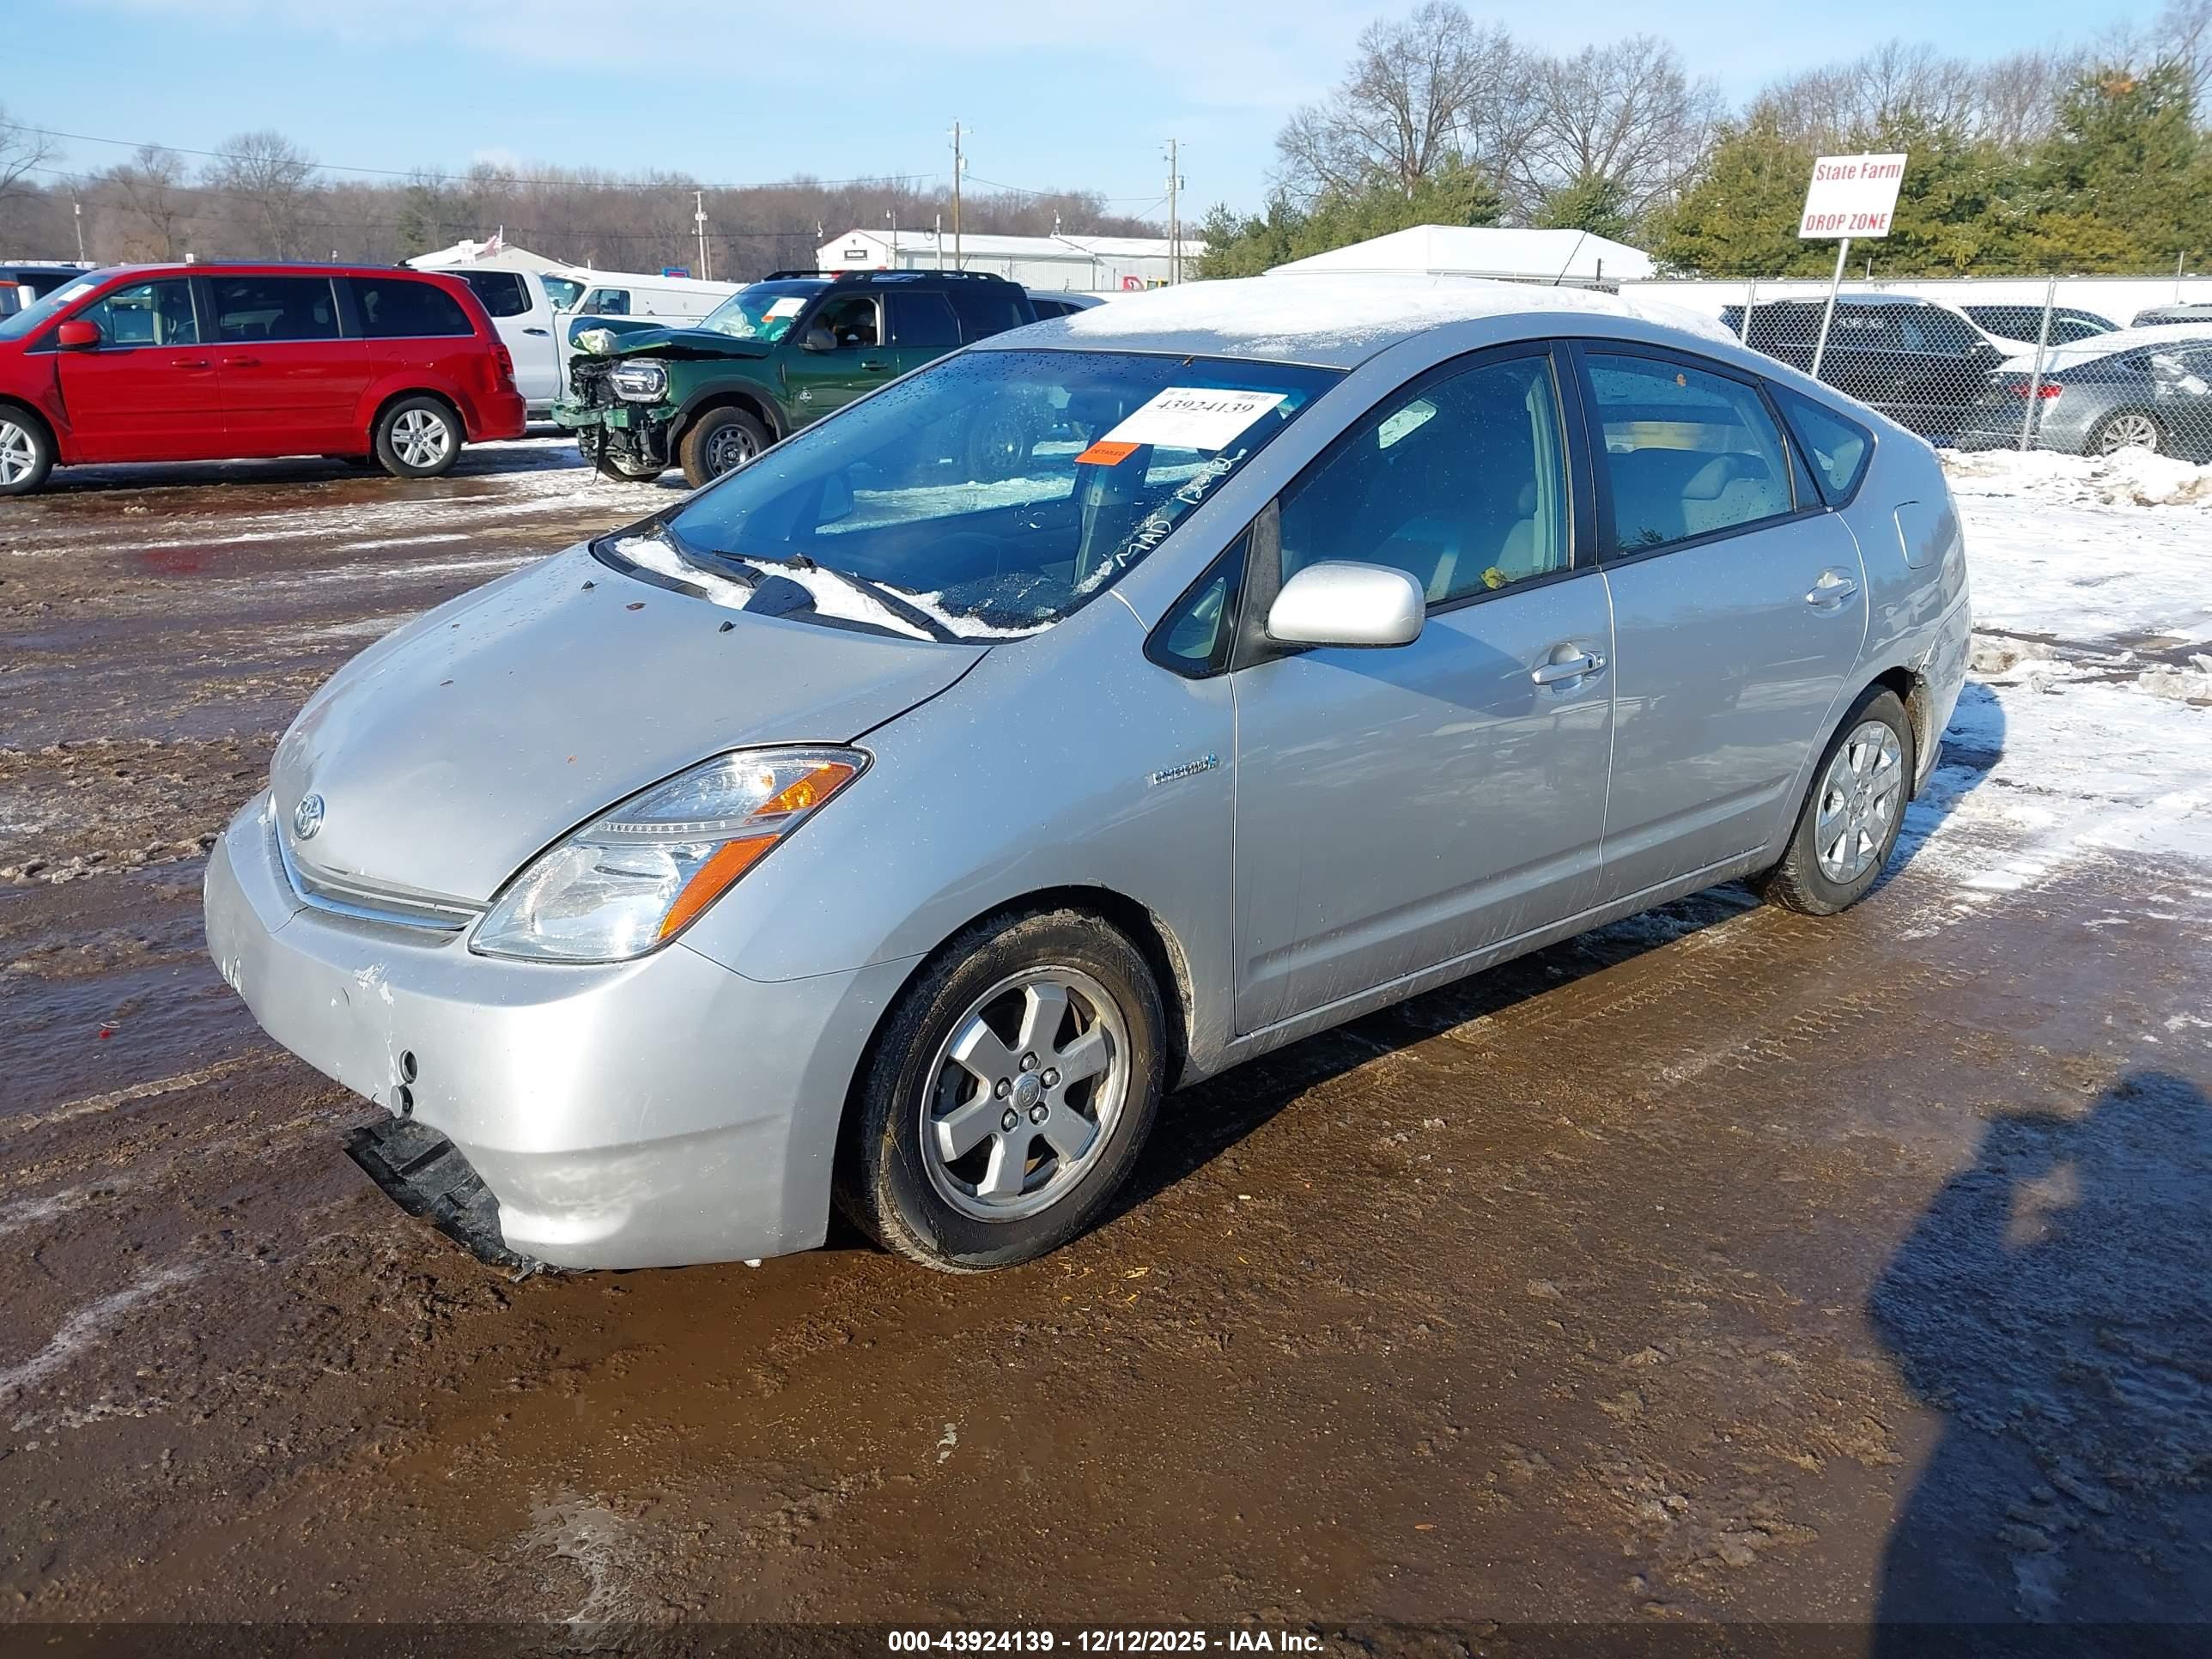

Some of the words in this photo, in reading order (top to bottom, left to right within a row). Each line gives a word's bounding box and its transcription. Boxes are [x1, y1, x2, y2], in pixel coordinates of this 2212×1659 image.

[1816, 164, 1856, 181] State
[1860, 162, 1901, 179] Farm
[1805, 214, 1846, 231] DROP
[1848, 213, 1888, 230] ZONE
[1156, 398, 1255, 414] 43924139
[1116, 520, 1172, 568] MAD
